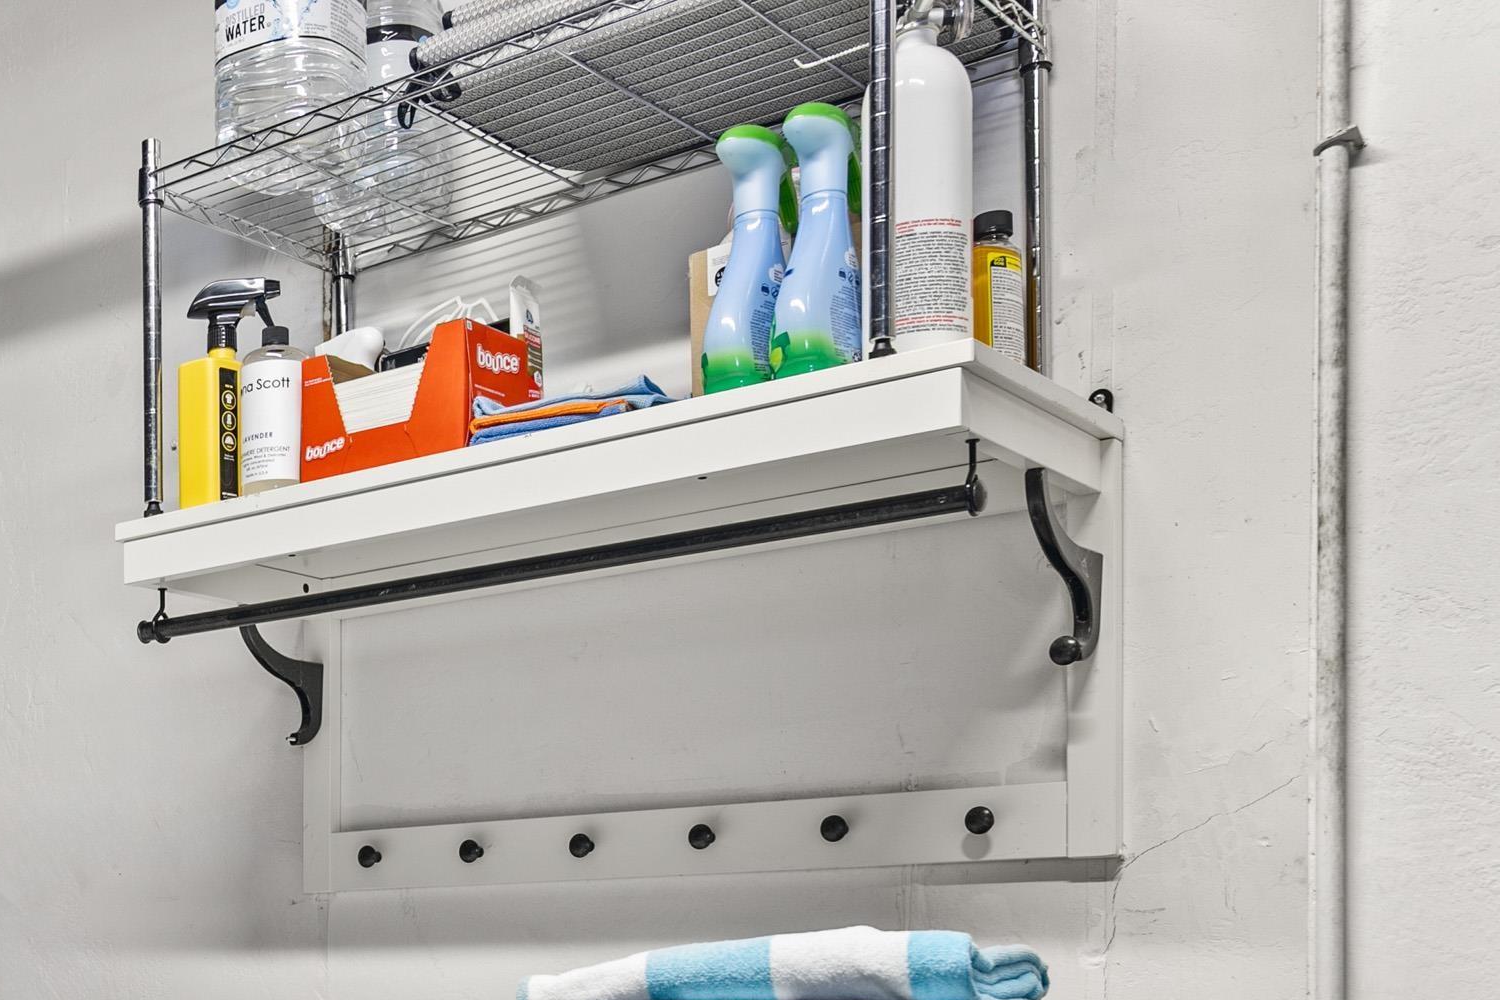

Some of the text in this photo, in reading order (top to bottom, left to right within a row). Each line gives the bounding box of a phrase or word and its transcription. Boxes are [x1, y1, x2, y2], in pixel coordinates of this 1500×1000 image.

[225, 15, 265, 42] WATER
[476, 343, 521, 374] bounce
[256, 377, 290, 390] Scott
[243, 432, 273, 444] AVENDER
[305, 437, 345, 461] bounce
